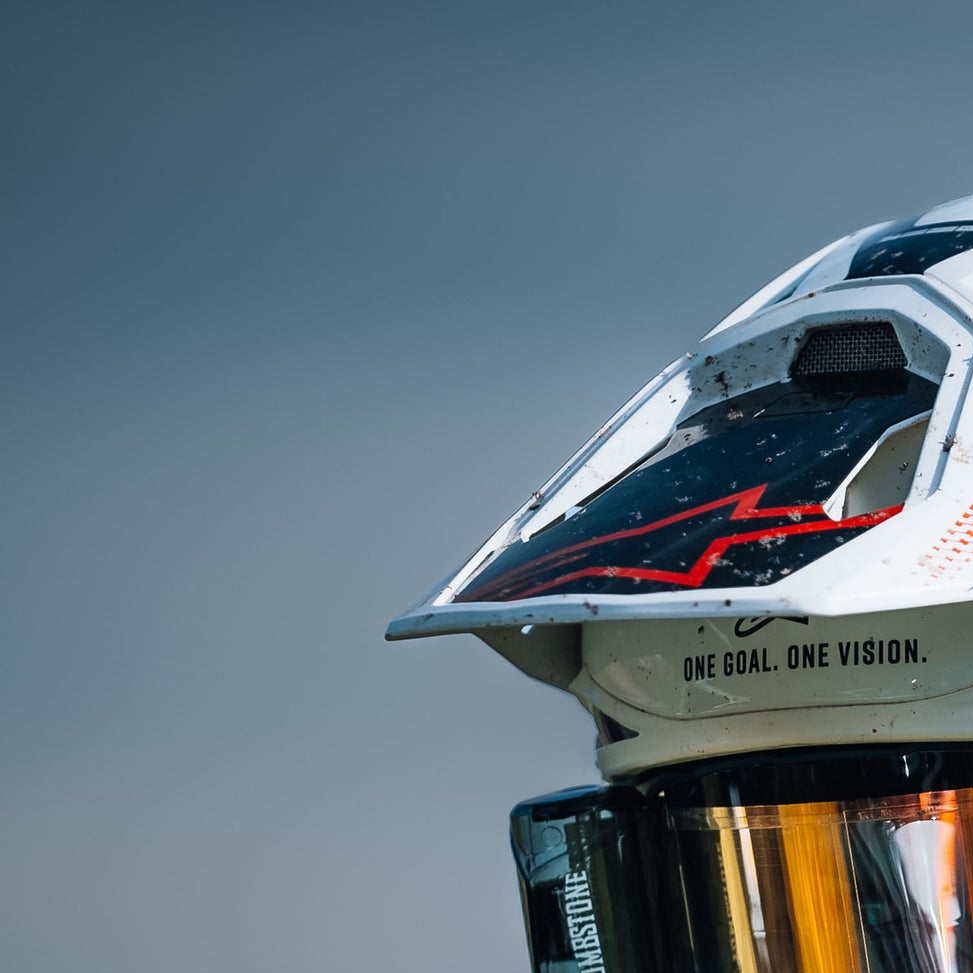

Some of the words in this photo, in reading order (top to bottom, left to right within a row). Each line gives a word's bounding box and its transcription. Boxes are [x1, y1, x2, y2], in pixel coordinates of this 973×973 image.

[684, 654, 716, 682] ONE
[723, 648, 778, 677] GOAL.
[787, 643, 829, 669] ONE
[838, 638, 928, 666] VISION.
